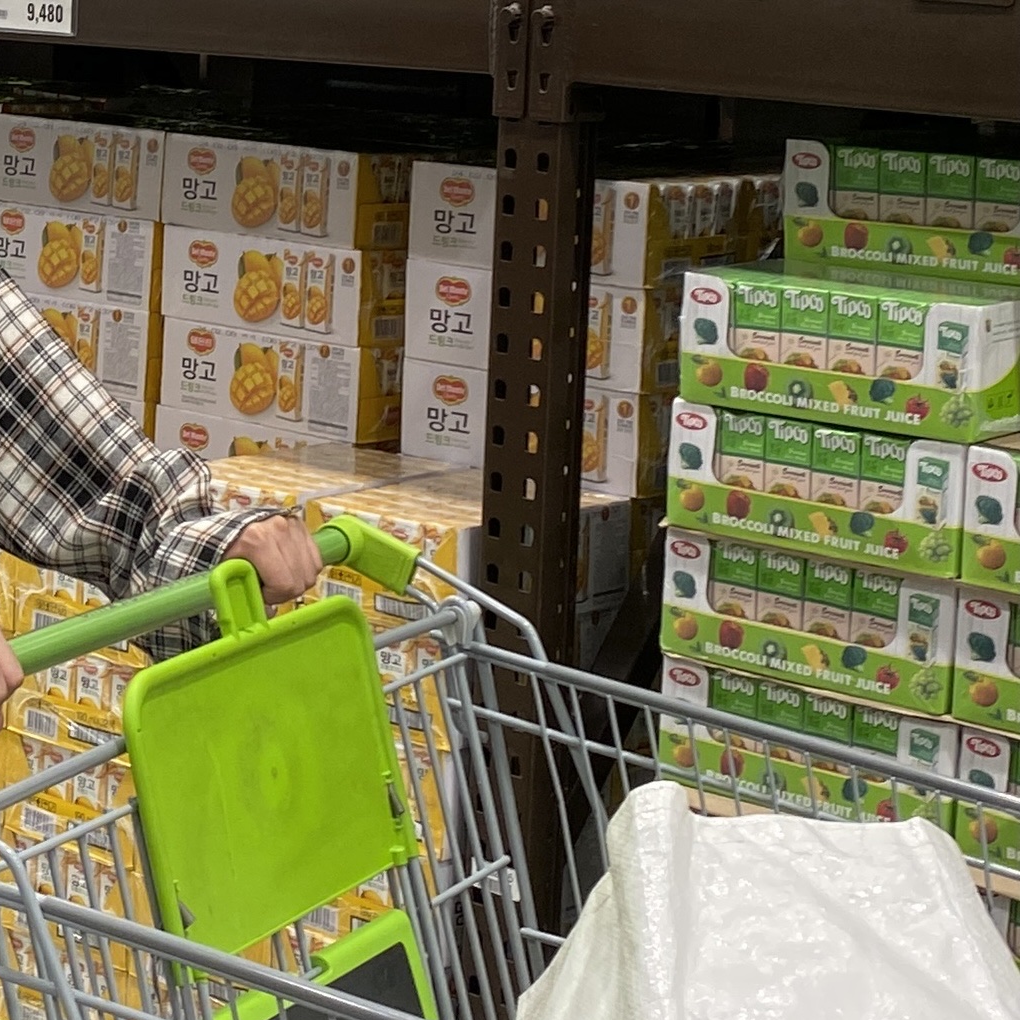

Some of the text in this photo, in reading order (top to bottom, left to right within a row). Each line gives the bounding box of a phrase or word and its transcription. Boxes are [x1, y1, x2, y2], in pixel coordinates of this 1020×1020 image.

[27, 3, 63, 24] 9,480
[4, 155, 37, 176] 망고
[838, 150, 876, 170] Tipco
[882, 152, 921, 174] Tipco
[930, 155, 970, 177] Tipco
[182, 177, 217, 201] 망고
[434, 209, 477, 235] 망고
[830, 245, 1018, 275] BROCCOLI MIXED FRUIT JUICE
[183, 270, 219, 294] 망고
[737, 285, 777, 307] Tipco
[783, 289, 824, 312] Tipco
[831, 295, 872, 319] Tipco
[429, 308, 474, 335] 망고
[881, 301, 923, 326] Tipco
[181, 357, 217, 382] 망고
[730, 386, 921, 425] BROCCOLI MIXED FRUIT JUICE
[427, 407, 471, 435] 망고
[723, 413, 763, 436] Tipco
[768, 420, 809, 444] Tipco
[815, 430, 855, 454] Tipco
[712, 512, 900, 560] BROCCOLI MIXED FRUIT JUICE
[380, 650, 402, 666] 망고
[705, 642, 892, 695] BROCCOLI MIXED FRUIT JUICE
[77, 775, 96, 790] 망고
